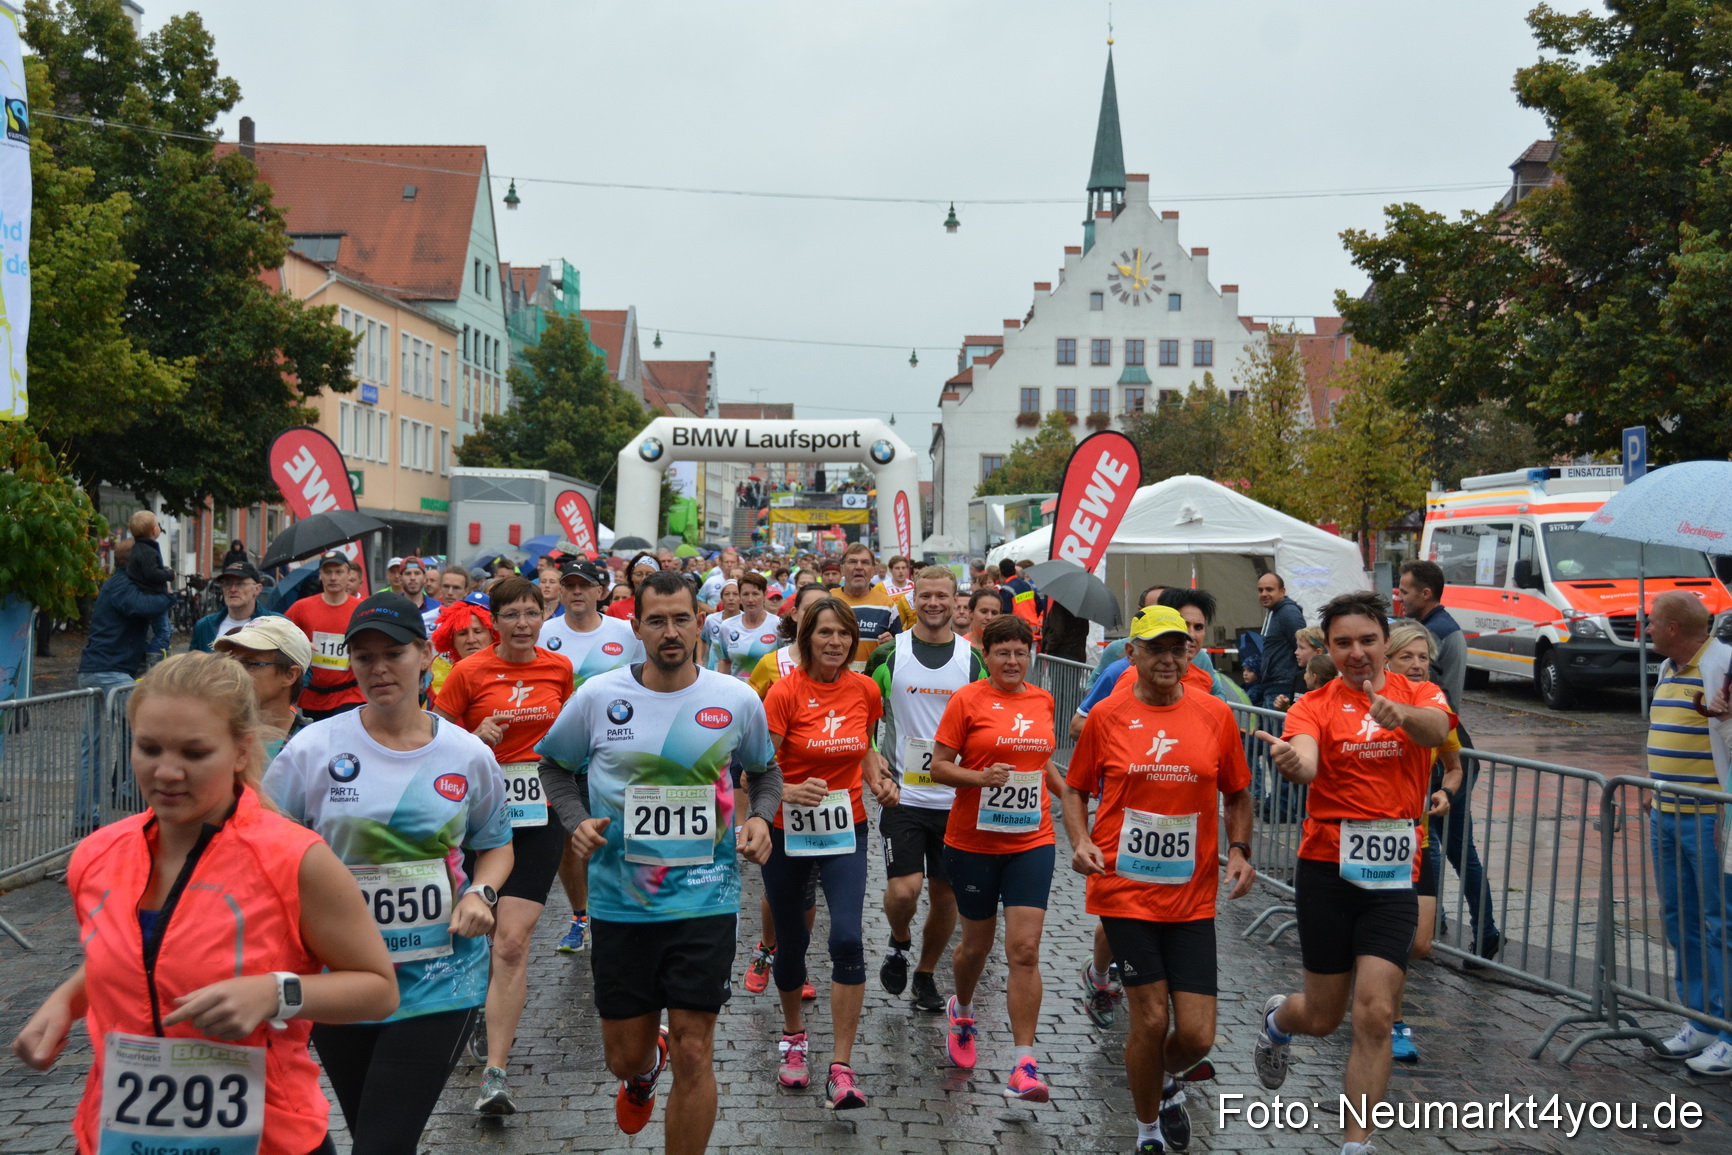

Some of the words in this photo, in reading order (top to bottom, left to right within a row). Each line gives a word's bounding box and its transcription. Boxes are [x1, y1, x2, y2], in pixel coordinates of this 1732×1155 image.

[672, 427, 738, 447] BMW
[745, 429, 861, 452] Laufsport
[1629, 437, 1641, 476] P
[1058, 450, 1129, 569] REWE
[700, 711, 729, 724] Hervis
[607, 728, 634, 737] PARTL
[806, 736, 860, 749] funrunners
[824, 742, 866, 754] neumarkt
[996, 736, 1048, 747] funrunners
[1341, 740, 1398, 754] funrunners
[1127, 763, 1190, 775] funrunners
[1146, 772, 1198, 783] neumarkt
[330, 787, 360, 796] PARTL
[665, 788, 708, 799] BOCK
[987, 785, 1038, 809] 2295
[634, 805, 708, 836] 2015
[790, 805, 848, 832] 3110
[992, 813, 1031, 824] Michaela
[1127, 827, 1190, 858] 3085
[1349, 834, 1410, 862] 2698
[1131, 860, 1163, 871] Ernst
[687, 873, 725, 886] Stadtlauf
[1360, 867, 1396, 879] Thomas
[360, 883, 443, 925] 650
[116, 1050, 162, 1062] NeuerMarkt
[172, 1043, 250, 1061] BOCK
[115, 1071, 249, 1129] 2293
